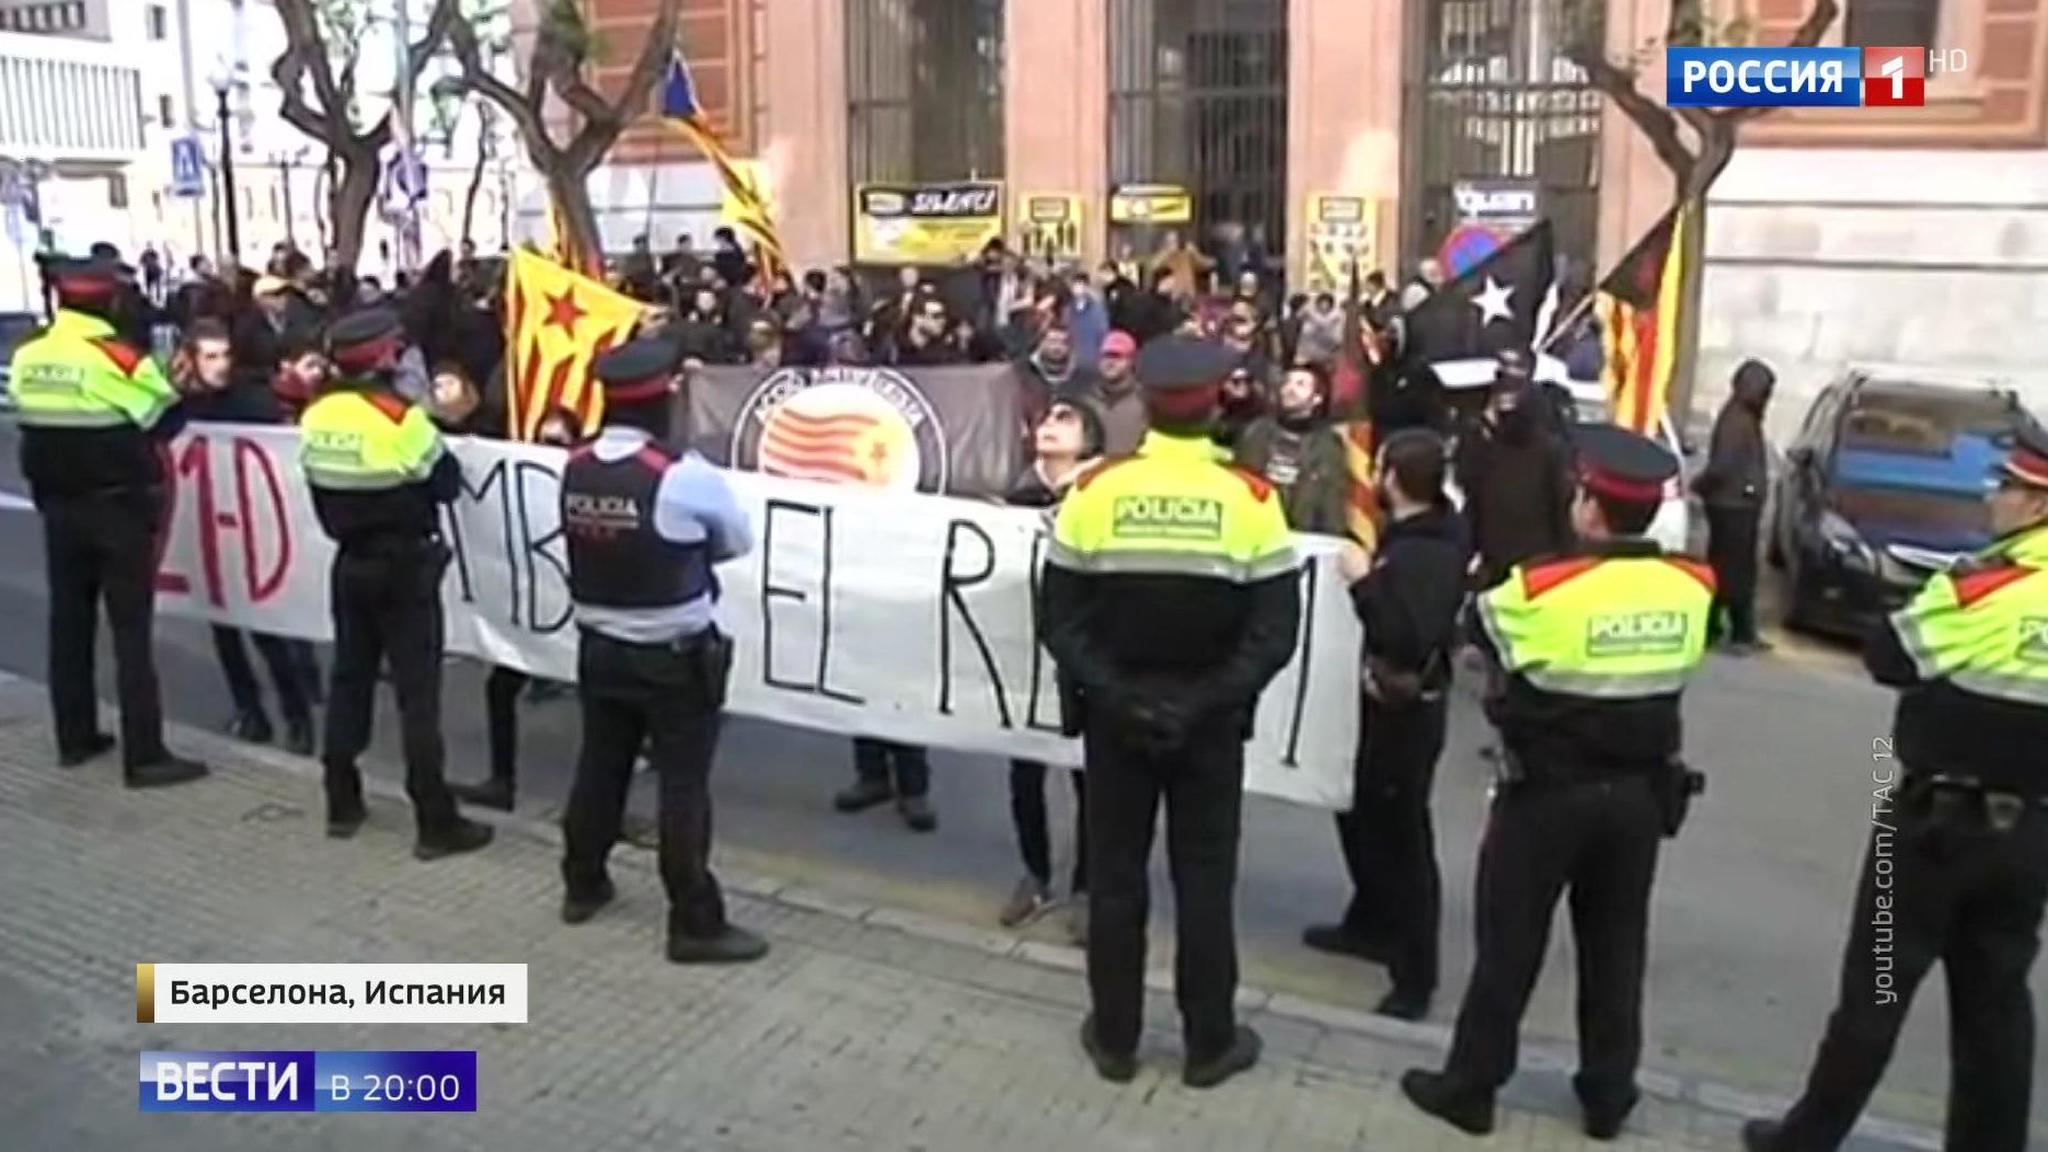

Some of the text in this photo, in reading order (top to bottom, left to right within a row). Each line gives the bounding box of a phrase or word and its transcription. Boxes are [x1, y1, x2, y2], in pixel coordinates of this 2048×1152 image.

[1114, 497, 1219, 521] POLICIA
[763, 499, 867, 704] EL
[1589, 612, 1684, 639] POLICIA
